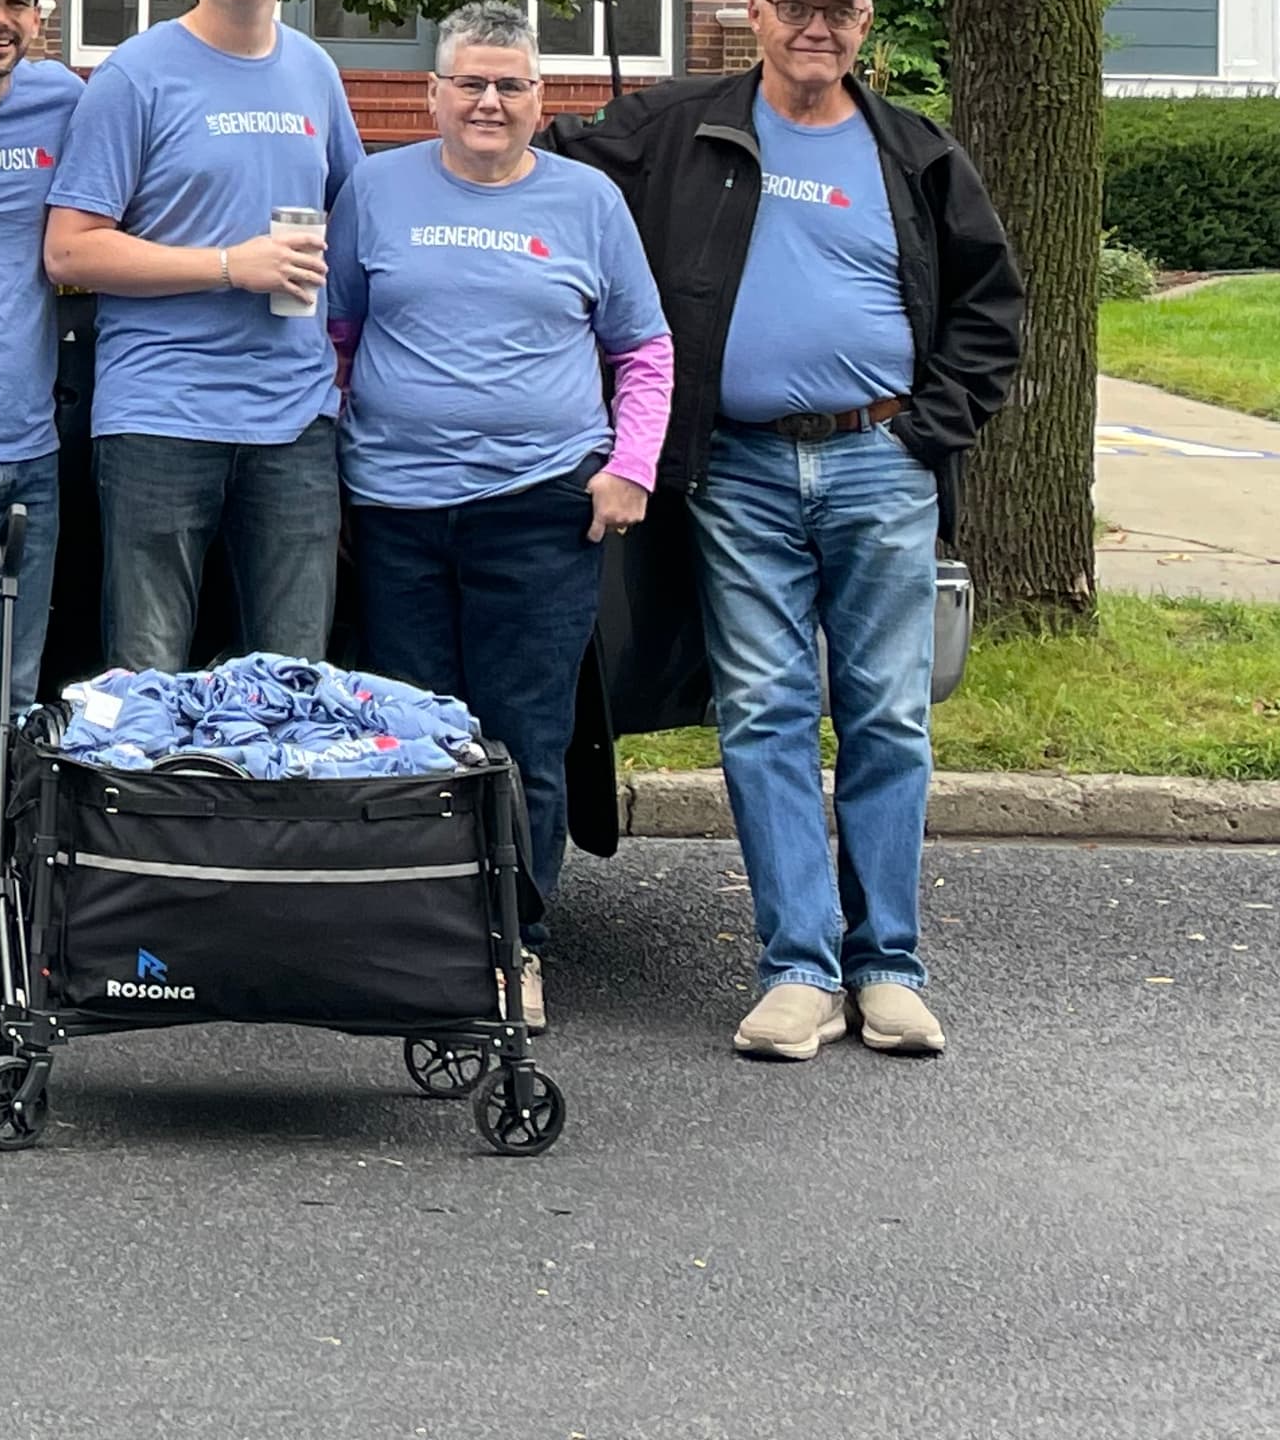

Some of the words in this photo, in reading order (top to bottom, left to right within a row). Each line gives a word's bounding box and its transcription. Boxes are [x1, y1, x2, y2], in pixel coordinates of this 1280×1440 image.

[219, 111, 305, 135] GENEROUSLY
[422, 225, 533, 254] GENEROUSLY
[106, 979, 196, 1000] ROSONG
